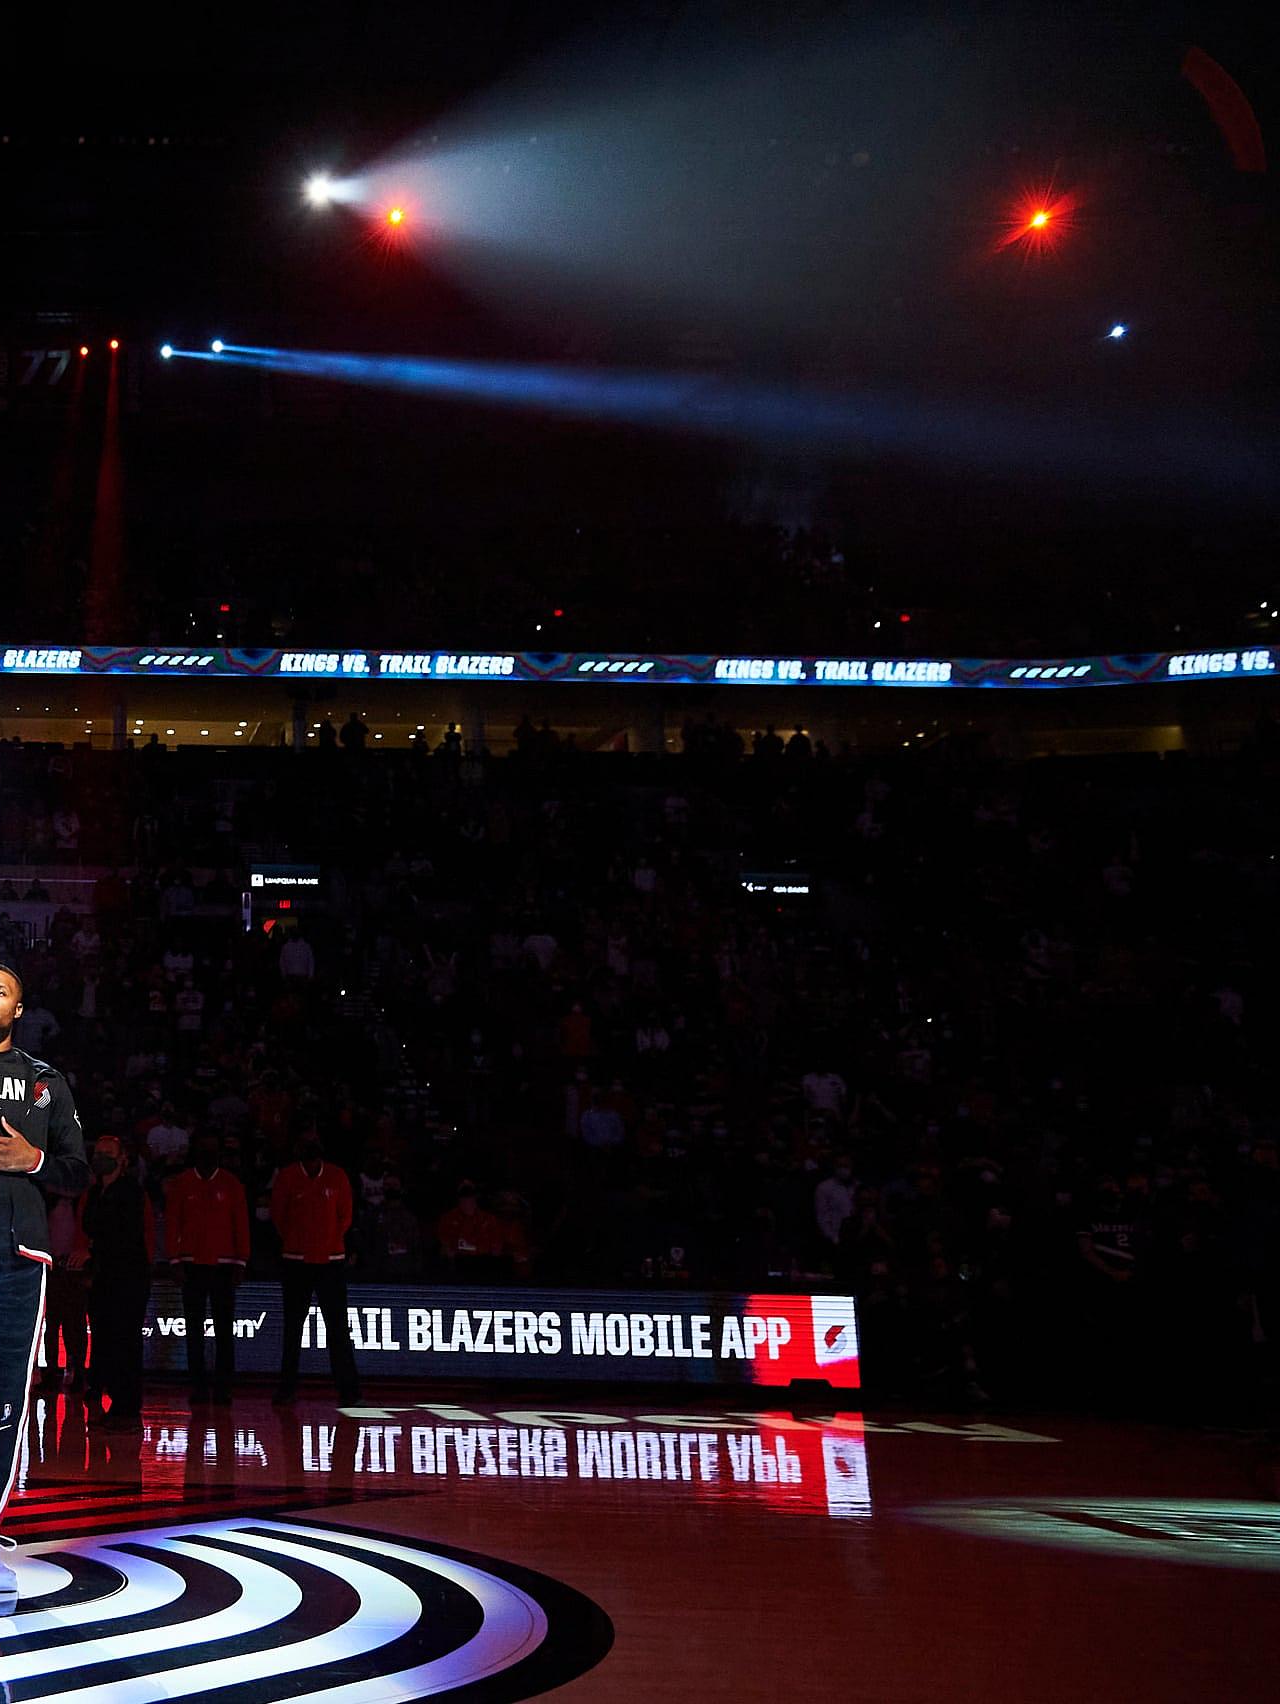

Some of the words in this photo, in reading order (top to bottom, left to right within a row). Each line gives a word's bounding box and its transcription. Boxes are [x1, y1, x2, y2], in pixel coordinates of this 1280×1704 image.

[3, 650, 82, 669] BLAZERS
[280, 654, 340, 672] KINGS
[342, 655, 370, 673] VS.
[379, 655, 431, 674] TRAIL
[435, 656, 515, 675] BLAZERS
[1168, 653, 1237, 675] KINGS
[1241, 651, 1275, 671] VS.
[715, 660, 775, 679] KINGS
[778, 661, 807, 680] VS.
[814, 661, 868, 681] TRAIL
[871, 662, 952, 682] BLAZERS
[408, 1309, 561, 1354] BLAZERS
[570, 1312, 713, 1358] MOBILE
[720, 1315, 792, 1360] APP
